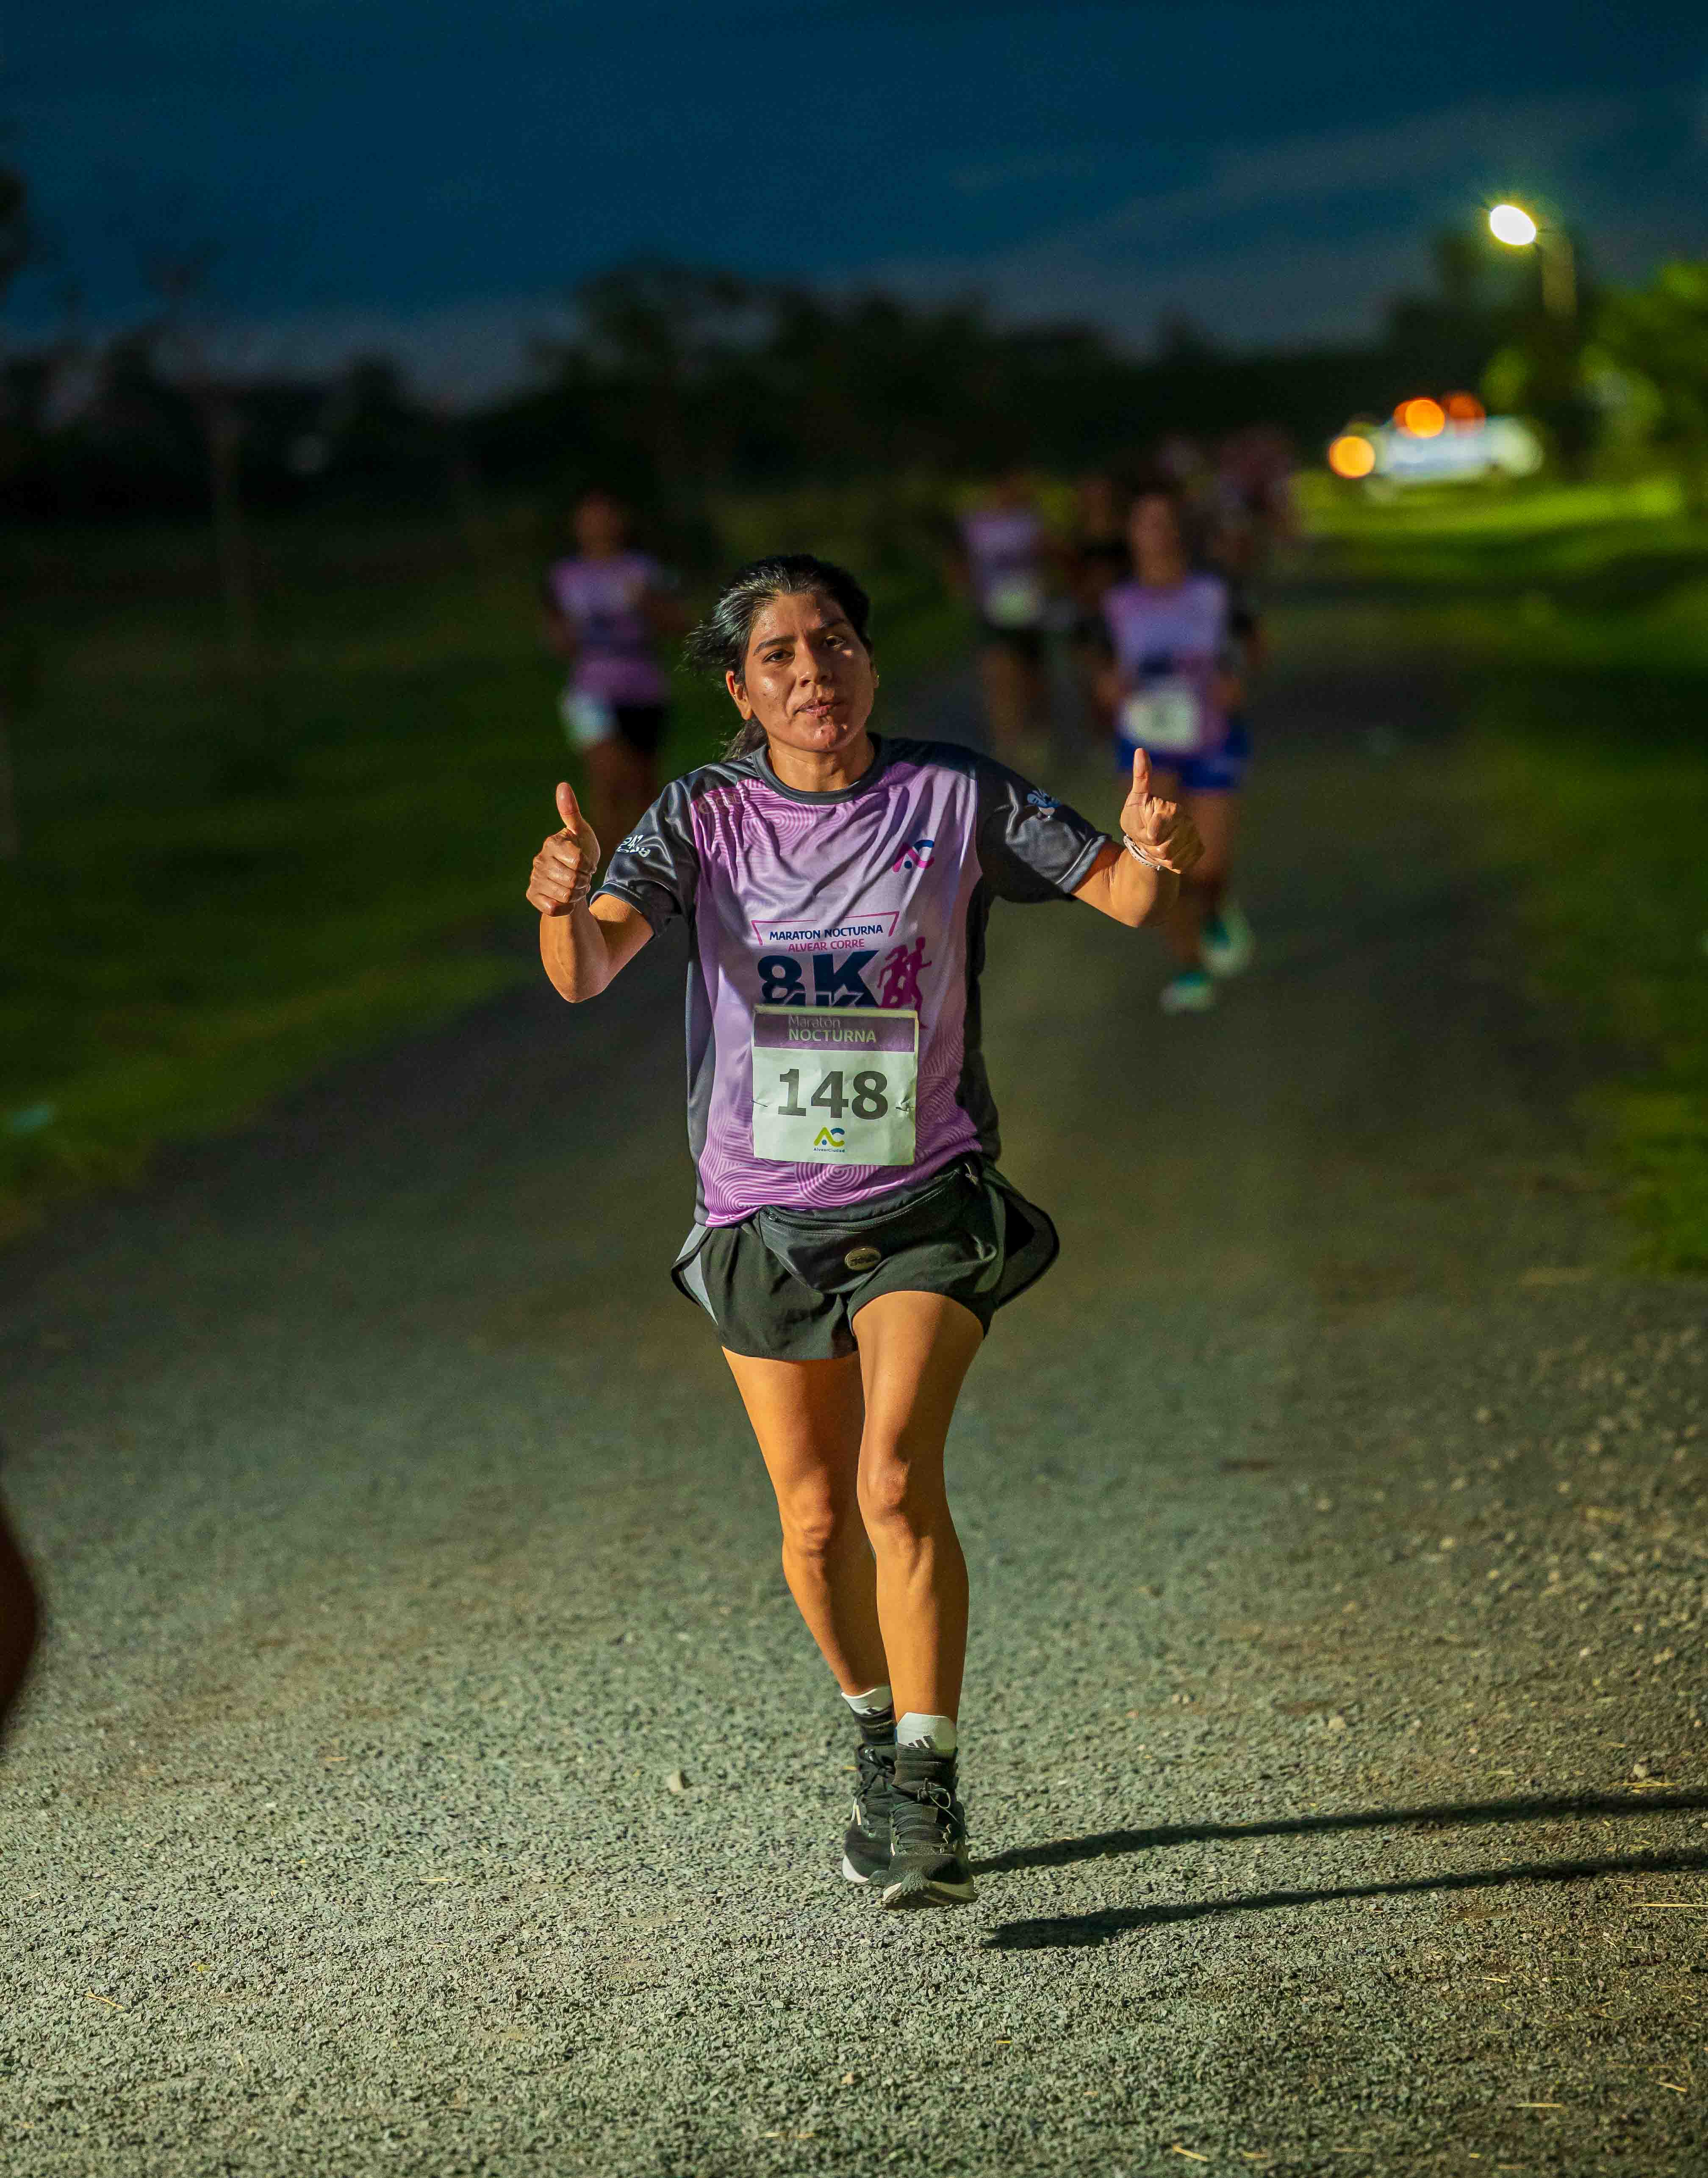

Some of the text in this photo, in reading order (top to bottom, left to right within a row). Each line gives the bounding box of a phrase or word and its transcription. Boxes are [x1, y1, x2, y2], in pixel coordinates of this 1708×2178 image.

[769, 924, 883, 941] MARATON NOCTURNA
[788, 938, 865, 952] ALVEAR CORRE
[788, 1029, 876, 1043] NOCTURNA
[778, 1068, 888, 1120] 148
